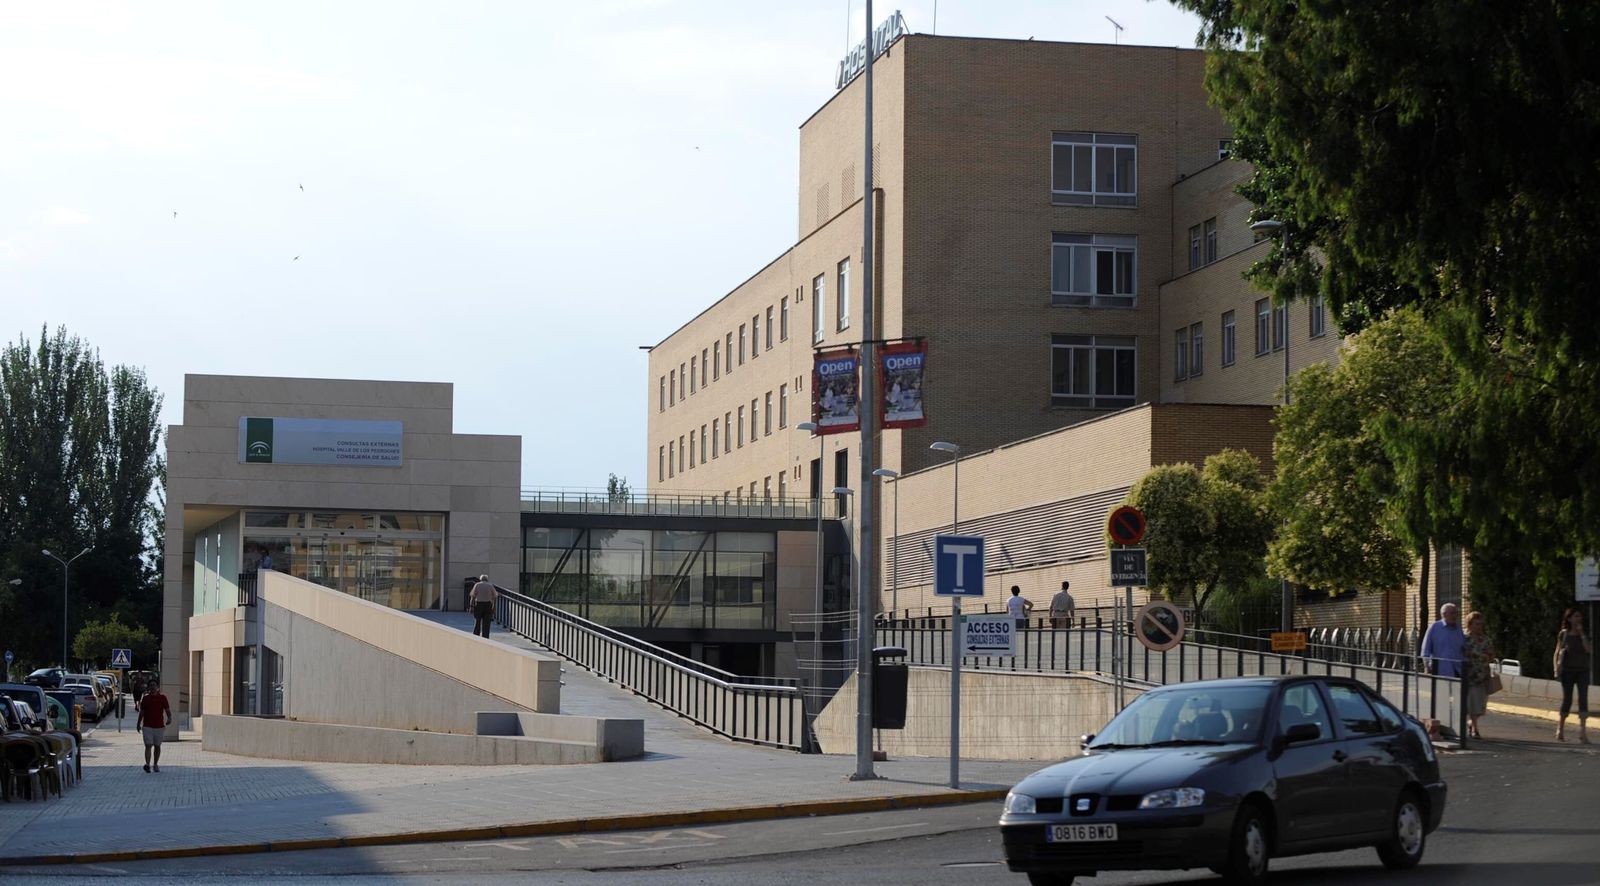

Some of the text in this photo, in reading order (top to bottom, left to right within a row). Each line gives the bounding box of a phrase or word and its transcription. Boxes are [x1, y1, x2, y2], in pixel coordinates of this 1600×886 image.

[842, 9, 903, 84] HOSITAL
[820, 361, 853, 376] Open
[886, 355, 921, 370] Open
[967, 622, 1010, 634] ACCESO
[966, 634, 1010, 645] CONSULTAS EXTERNAS
[1055, 826, 1086, 840] 0816
